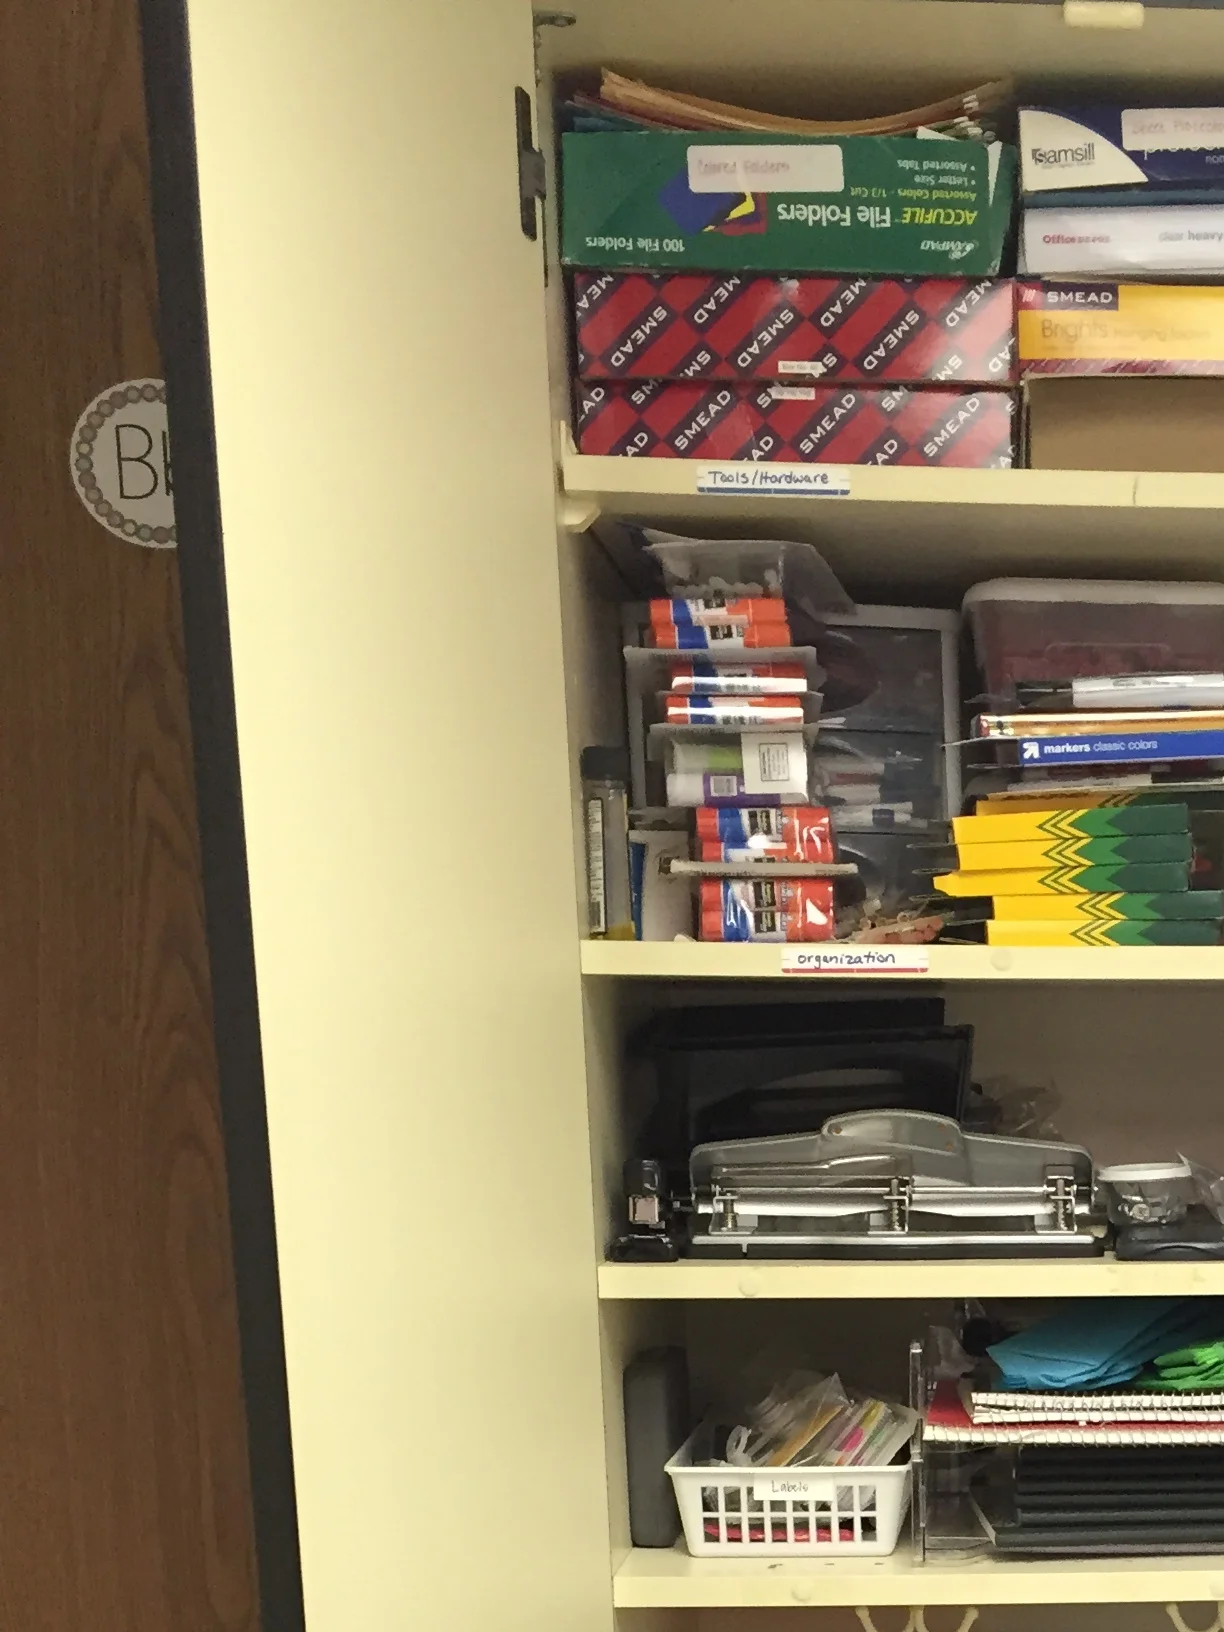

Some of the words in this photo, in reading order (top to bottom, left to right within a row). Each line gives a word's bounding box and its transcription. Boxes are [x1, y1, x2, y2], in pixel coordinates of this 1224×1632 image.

[896, 188, 929, 200] Colors
[930, 189, 977, 202] Assorted
[776, 203, 851, 228] Folders
[856, 204, 891, 228] File
[900, 208, 978, 225] ACCUFILE
[585, 235, 635, 252] Folders
[636, 237, 661, 252] File
[663, 237, 686, 252] 100
[1187, 229, 1223, 243] heavy
[693, 275, 742, 324] MEAD
[819, 278, 868, 328] MEAD
[945, 279, 993, 328] MEAD
[1046, 290, 1114, 304] SMEAD
[610, 305, 668, 368] SMEAD
[736, 308, 795, 368] SMEAD
[863, 309, 920, 370] SMEAD
[673, 389, 731, 451] SMEAD
[799, 392, 856, 454] SMEAD
[923, 396, 981, 457] SMEAD
[1043, 742, 1091, 755] markers
[1093, 740, 1125, 752] classic
[1127, 739, 1158, 751] colors
[796, 949, 896, 970] organization
[770, 1479, 810, 1495] Labels
